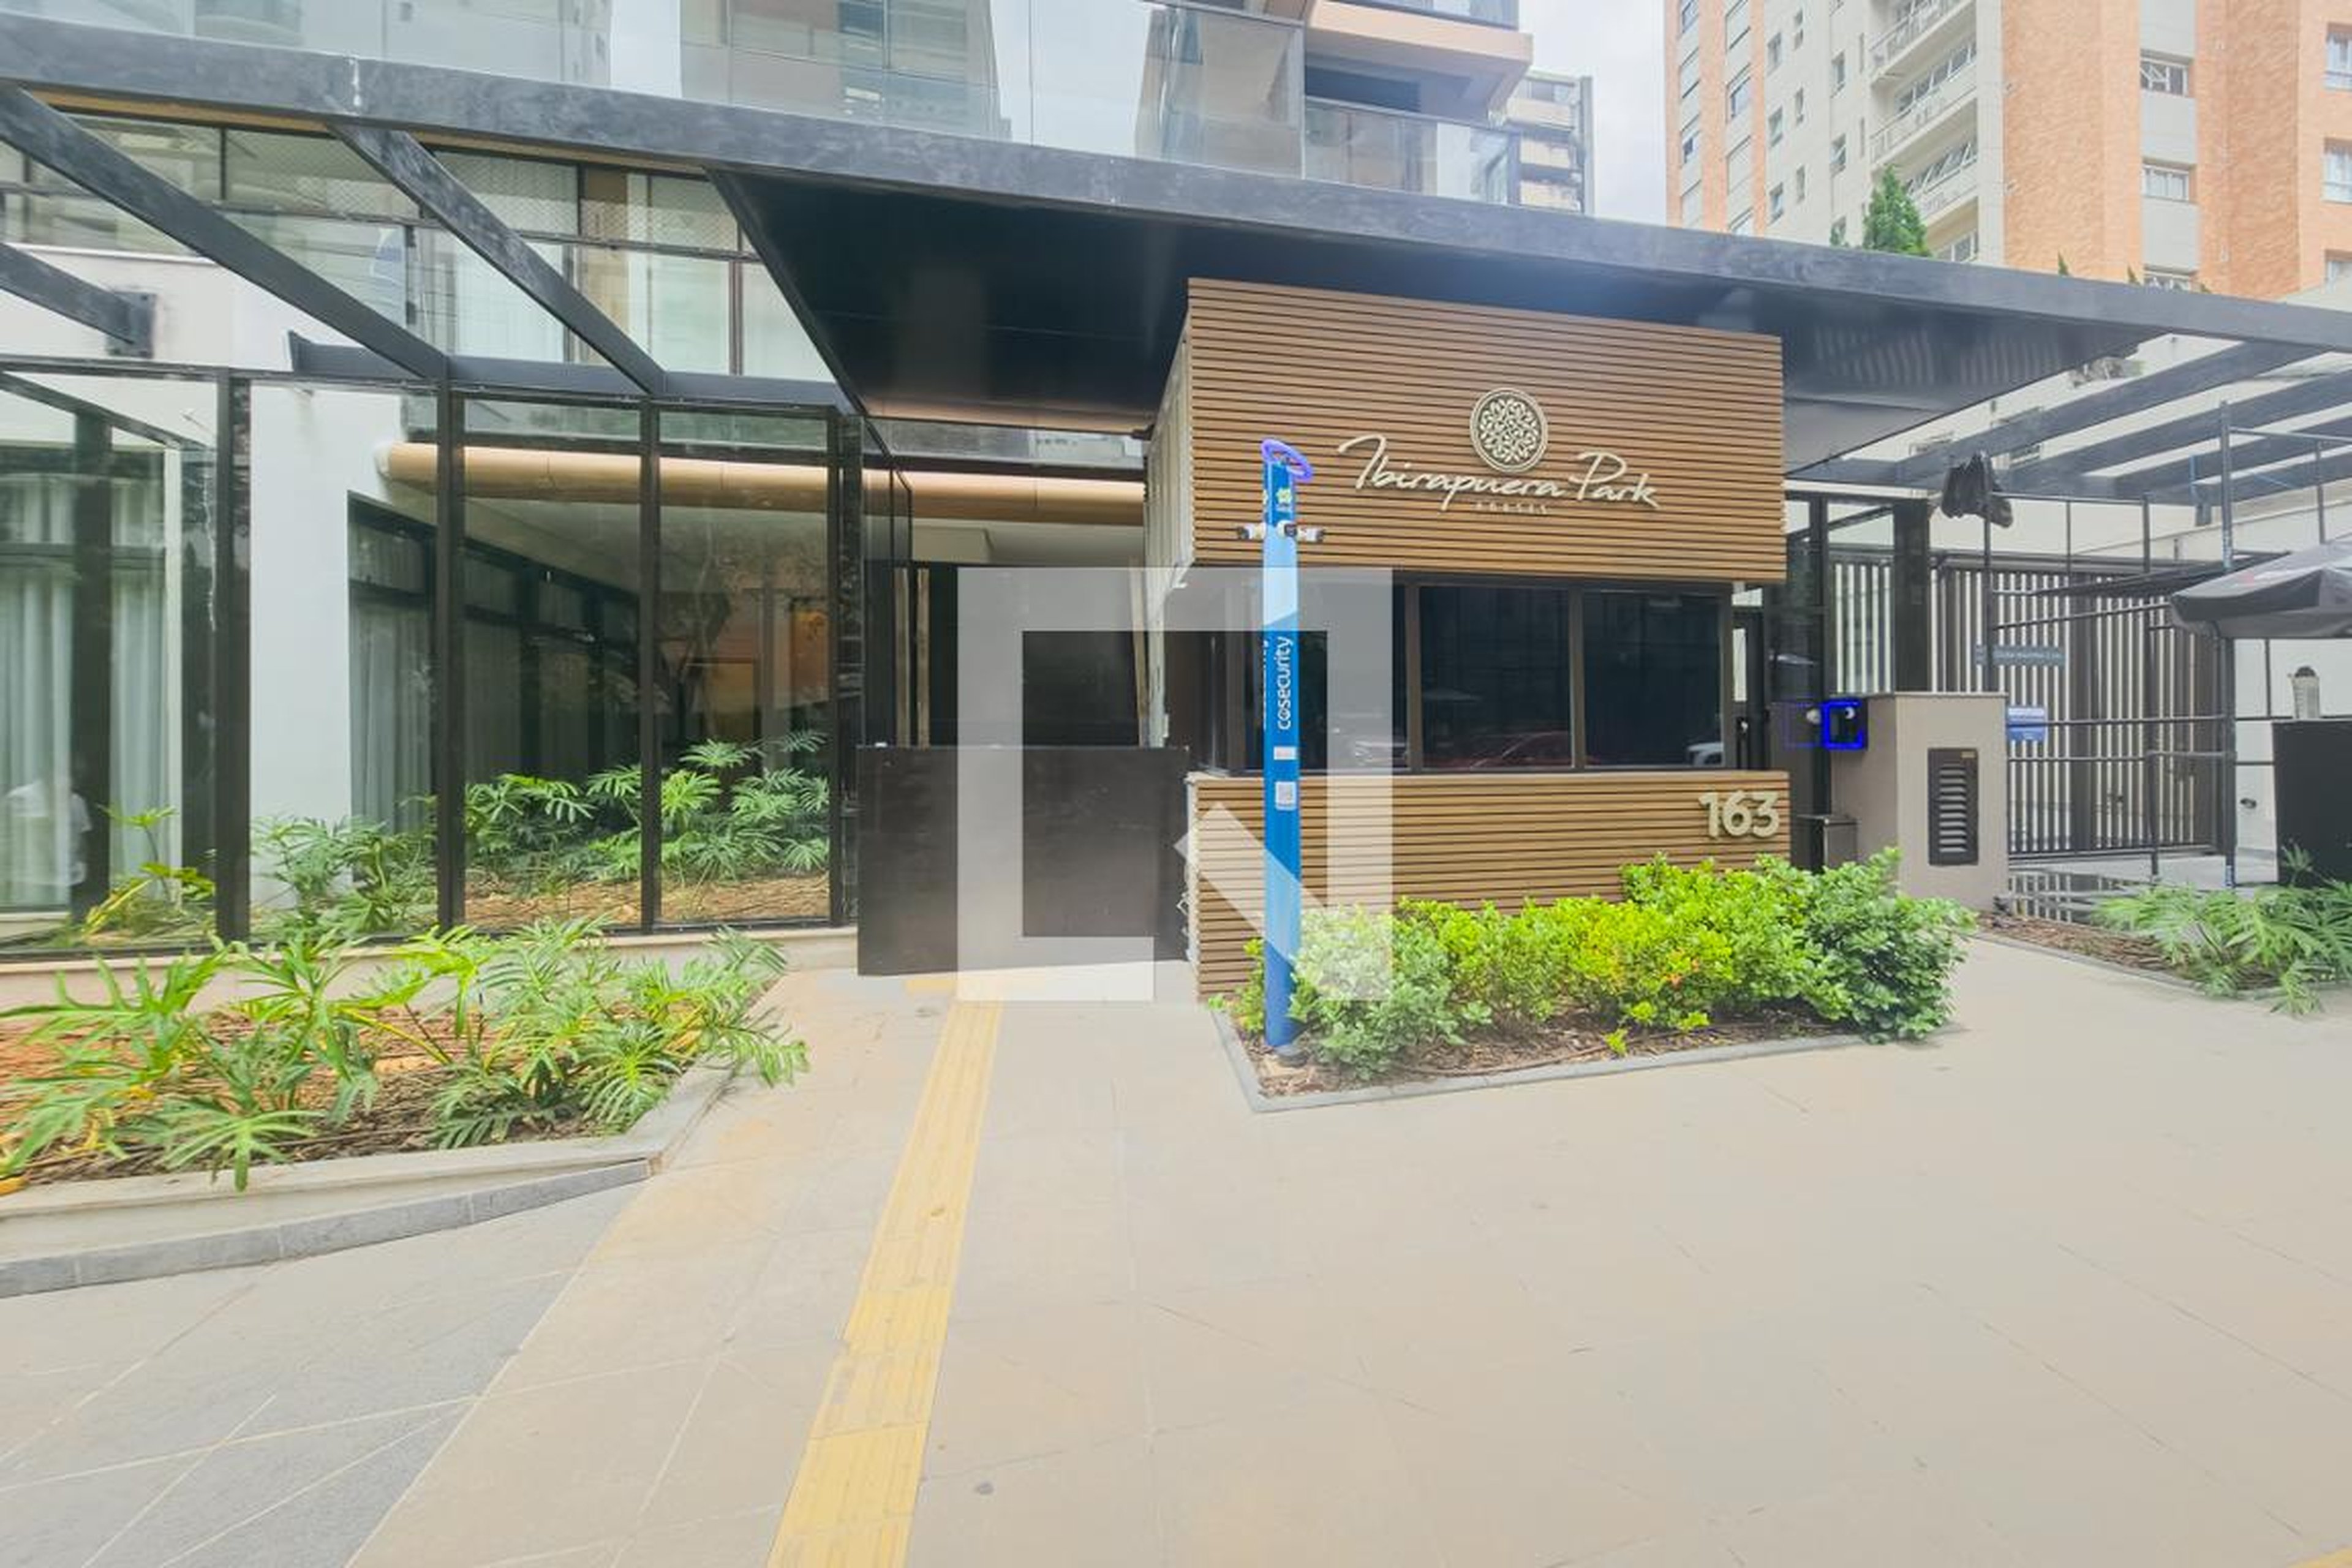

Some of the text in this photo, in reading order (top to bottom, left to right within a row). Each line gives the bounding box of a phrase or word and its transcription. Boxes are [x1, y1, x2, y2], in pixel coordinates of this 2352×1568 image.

[1338, 434, 1660, 511] Ibirapuera Park
[1273, 636, 1293, 729] cosecurity
[1698, 790, 1779, 837] 163
